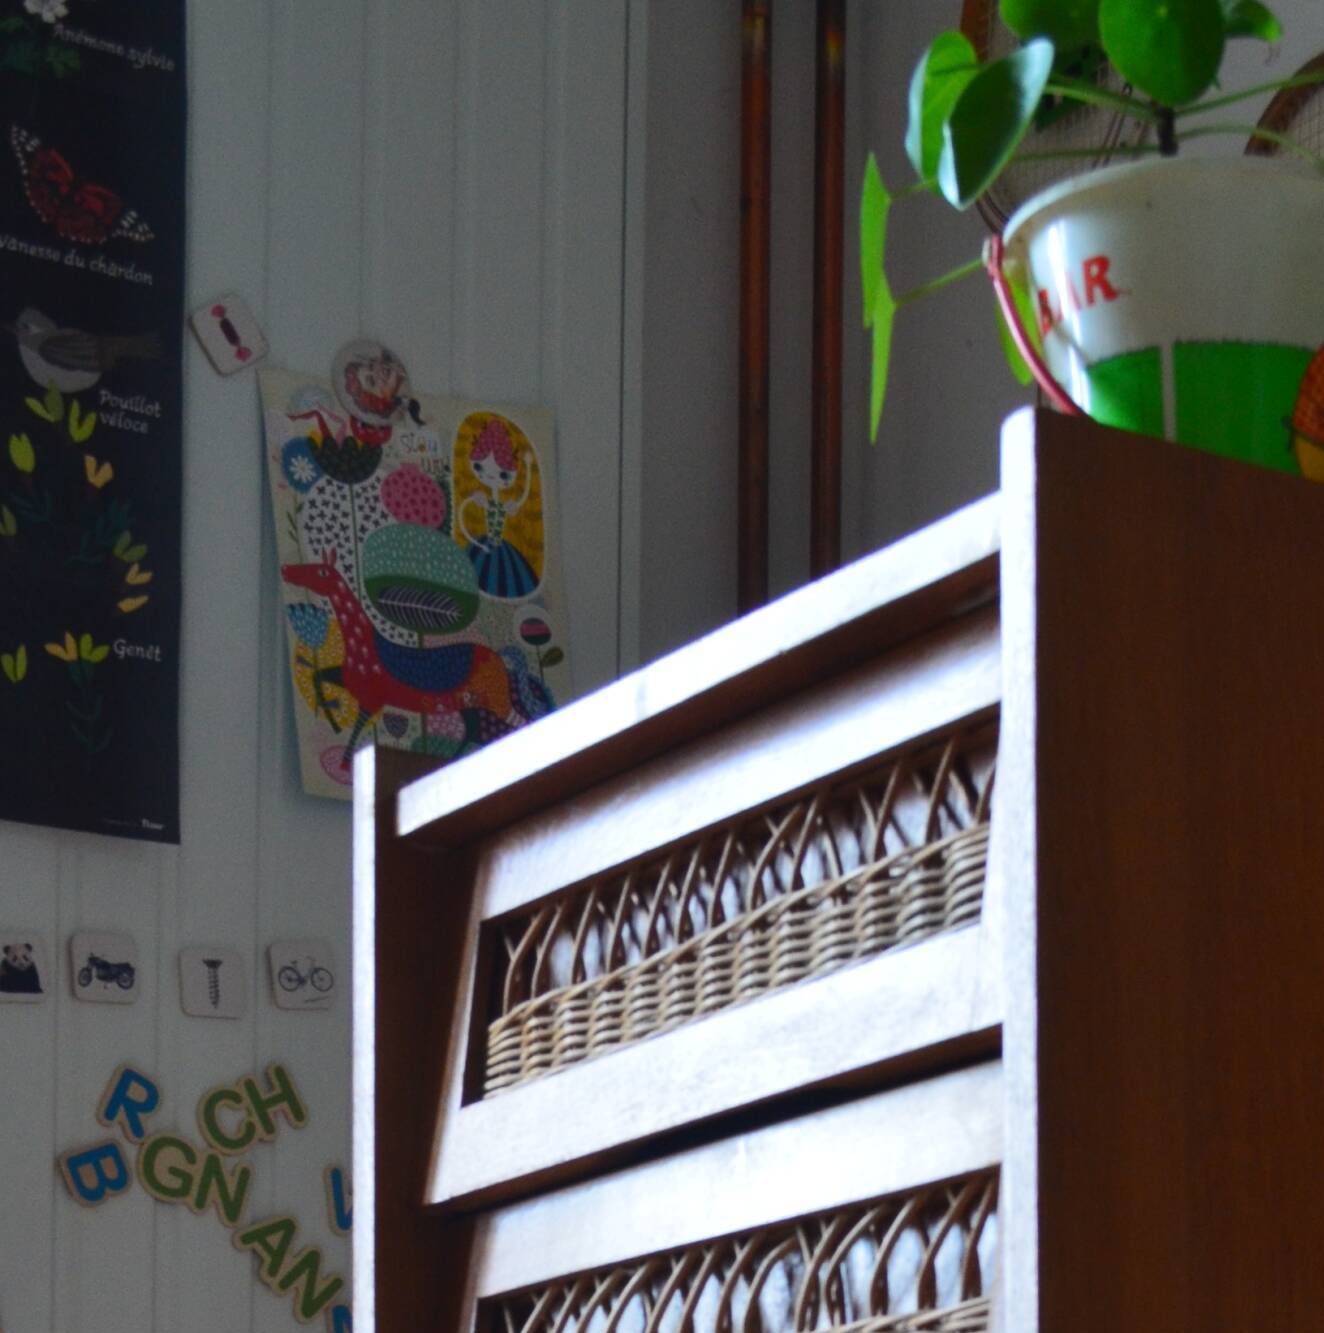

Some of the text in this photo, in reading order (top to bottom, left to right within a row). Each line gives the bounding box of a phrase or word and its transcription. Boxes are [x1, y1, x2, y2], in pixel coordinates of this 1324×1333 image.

[63, 248, 86, 269] du
[89, 255, 153, 286] chardon
[100, 389, 161, 419] Pouillot
